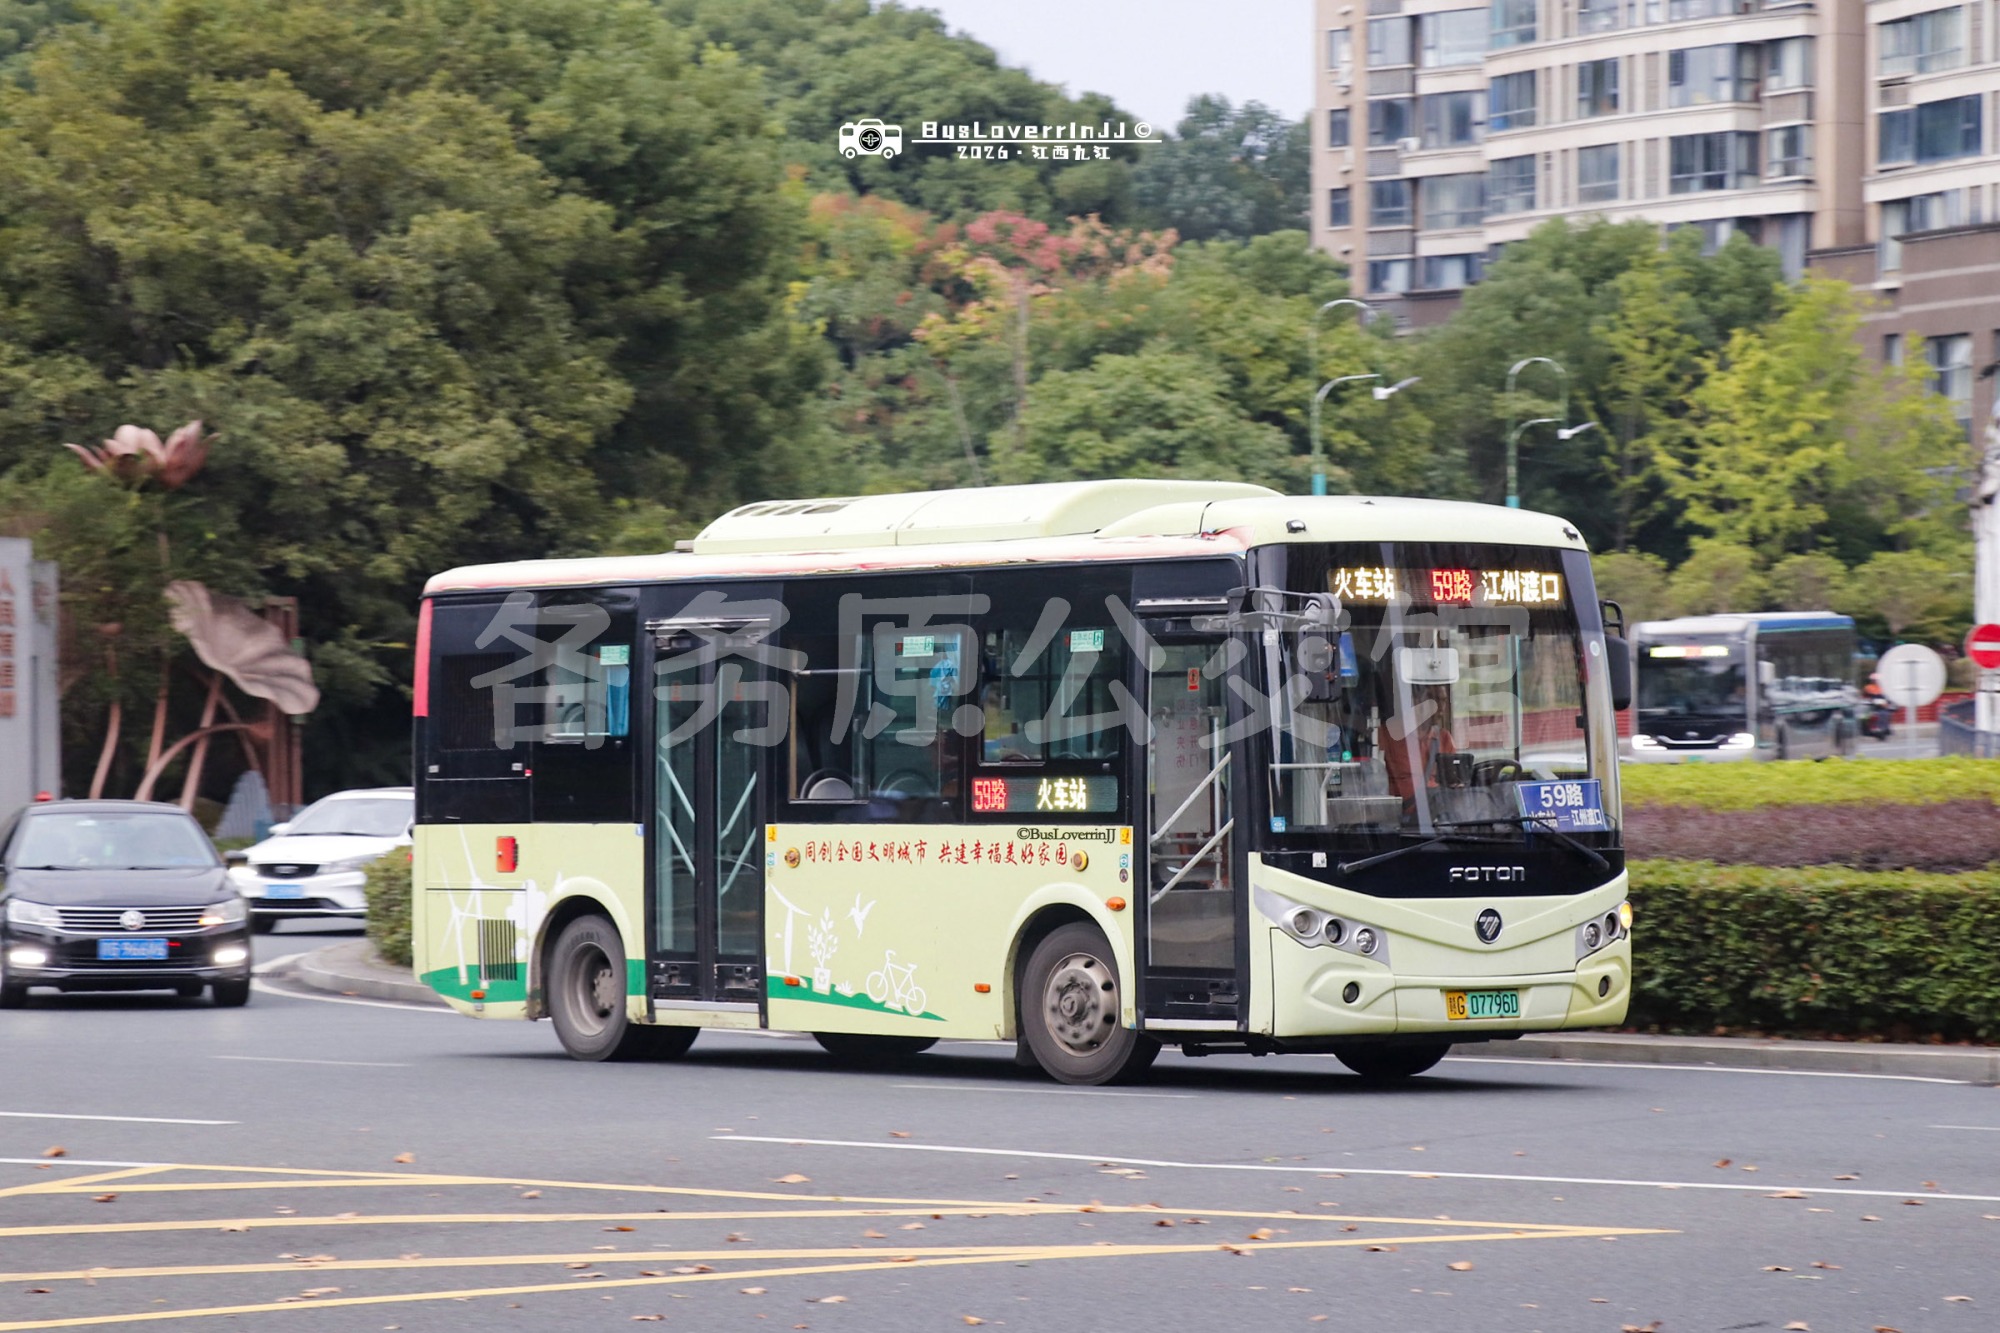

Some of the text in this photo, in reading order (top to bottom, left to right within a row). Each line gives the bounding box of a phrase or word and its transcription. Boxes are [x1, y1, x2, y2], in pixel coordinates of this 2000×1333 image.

[1334, 566, 1560, 602] 火车站 59路 江州渡口
[974, 777, 1087, 810] 59路 火车站
[1540, 783, 1584, 808] 59路
[805, 839, 1068, 866] 同创全国文明城市 共建幸福美好家园
[1449, 866, 1525, 882] FOTON
